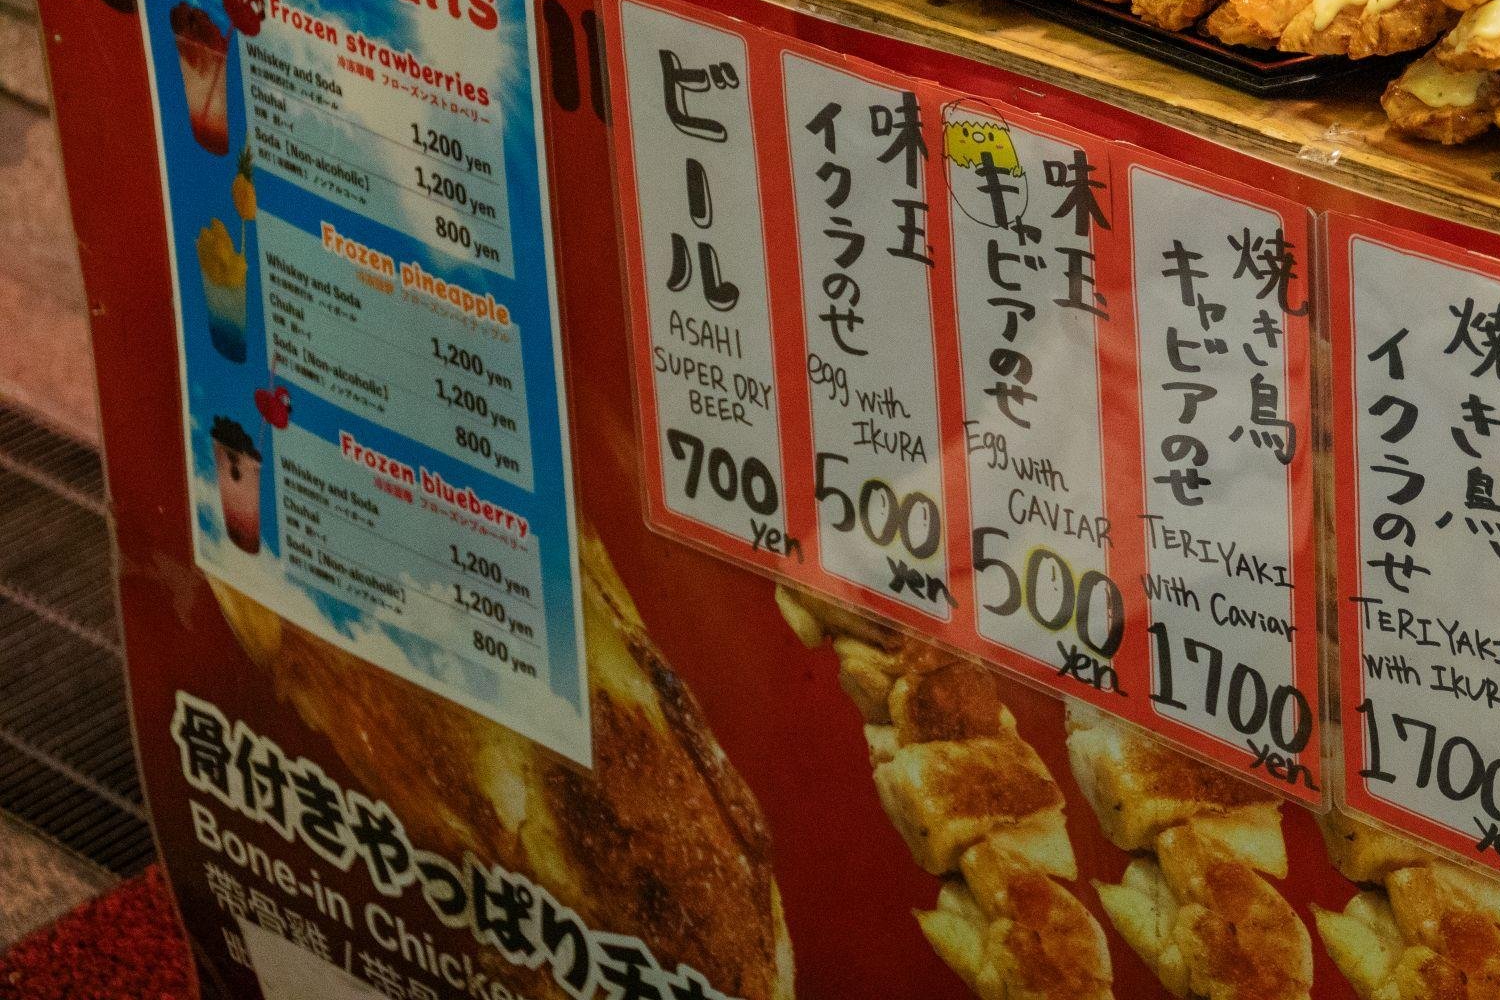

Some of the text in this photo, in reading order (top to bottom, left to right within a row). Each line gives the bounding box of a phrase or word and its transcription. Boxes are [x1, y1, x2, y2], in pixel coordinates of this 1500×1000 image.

[246, 42, 291, 76] Whiskey
[293, 65, 313, 83] and
[315, 72, 343, 98] Soda
[251, 85, 287, 113] Chuhai
[346, 32, 490, 107] strawberries
[254, 126, 281, 151] Soda
[411, 123, 492, 176] 1,200 yen
[415, 166, 496, 221] 1,200 yen
[658, 49, 740, 312] ビール
[867, 91, 936, 269] 味玉
[435, 215, 501, 264] 800 yen
[804, 101, 869, 357] イクラのせ
[1042, 149, 1112, 321] 味玉
[266, 251, 309, 287] Whiskey
[311, 276, 332, 296] and
[322, 222, 395, 275] Frozen
[402, 263, 510, 326] pineapple
[974, 151, 1048, 430] キャビアのせ
[431, 336, 514, 391] 1,200 yen
[669, 308, 743, 359] ASAHI
[1226, 226, 1310, 466] 焼き鳥
[652, 346, 772, 411] SUPER DRY
[807, 352, 850, 408] egg
[1152, 238, 1229, 507] キャビアのせ
[435, 379, 517, 432] 1,200 yen
[688, 389, 754, 427] BEER
[455, 425, 521, 473] 800 yen
[962, 420, 1009, 470] Egg
[1366, 327, 1432, 594] イクラのせ
[340, 432, 415, 485] Frozen
[420, 468, 529, 539] blueberry
[665, 427, 805, 564] 700 yen
[814, 451, 960, 609] 500 yen
[1007, 487, 1115, 549] CAVIAR
[450, 545, 531, 600] 1,200 yen
[1135, 514, 1296, 590] TERIYAKI
[454, 584, 534, 640] 1,200 yen
[972, 526, 1129, 697] 500 yen
[1209, 592, 1299, 643] Caviar
[472, 630, 537, 679] 800 yen
[1146, 621, 1322, 792] 1700 yen
[189, 798, 355, 930] Bone-in
